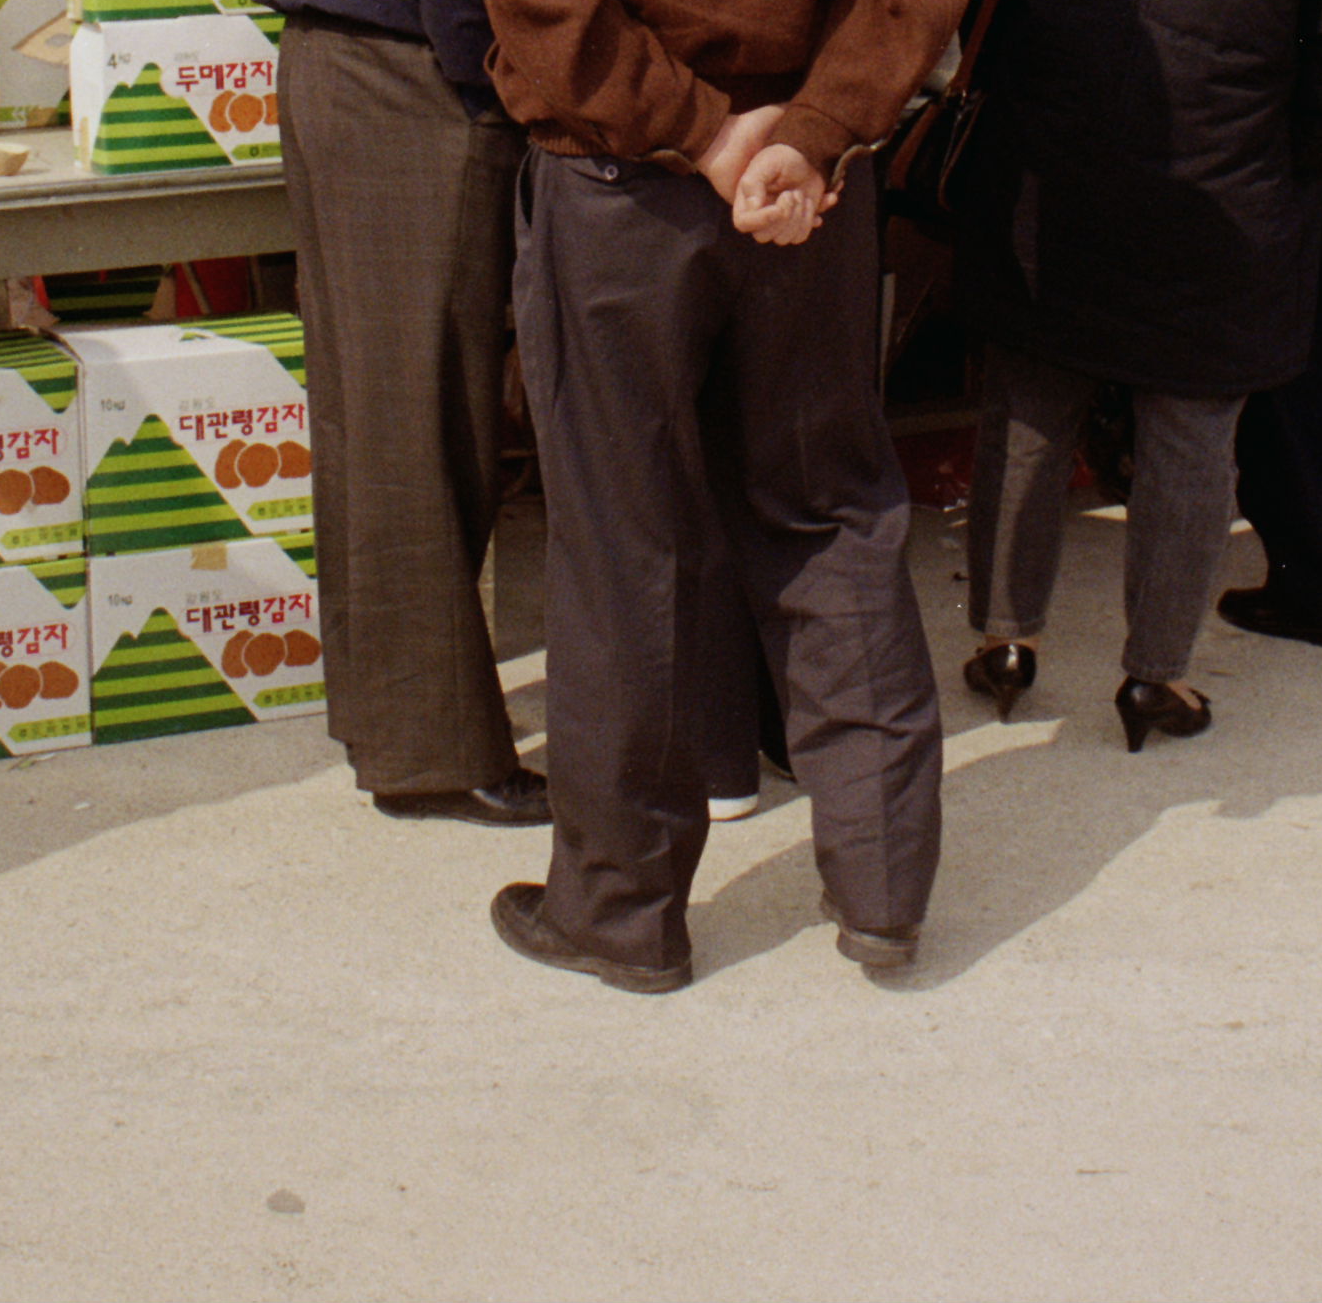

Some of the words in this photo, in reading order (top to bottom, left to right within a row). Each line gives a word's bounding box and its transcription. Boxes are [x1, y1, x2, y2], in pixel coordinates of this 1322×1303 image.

[175, 60, 273, 93] 두메감자
[178, 403, 306, 440] 대관령감자
[185, 593, 314, 634] 대관령감자
